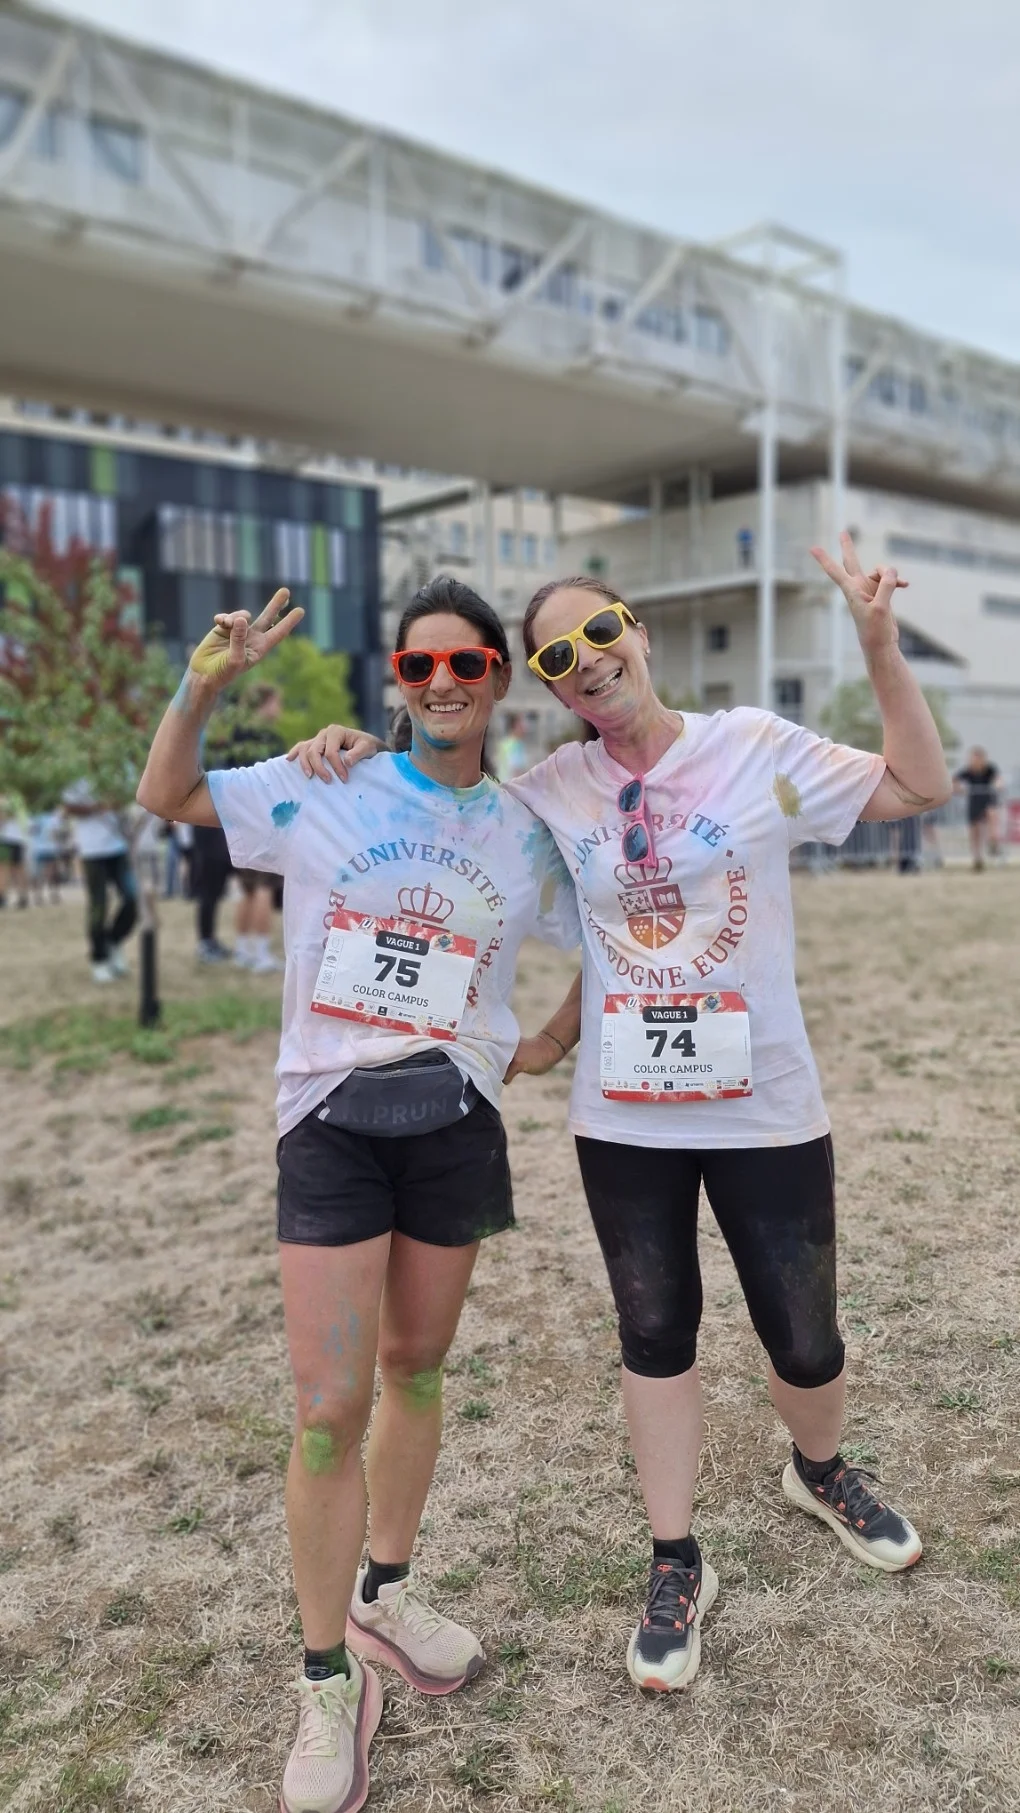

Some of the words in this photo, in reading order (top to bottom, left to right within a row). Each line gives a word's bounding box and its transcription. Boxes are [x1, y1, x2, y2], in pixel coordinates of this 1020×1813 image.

[574, 811, 730, 865] UNIVRSITÉ
[348, 838, 507, 912] UNIVERSITÉ
[690, 865, 748, 979] EUROPE
[386, 936, 414, 950] VAGUE
[415, 943, 420, 951] 1
[374, 953, 421, 988] 75
[466, 937, 504, 1007] ROPE
[352, 984, 386, 999] COLOR
[387, 992, 429, 1008] CAMPUS
[651, 1011, 682, 1019] VAGUE
[683, 1011, 688, 1019] 1
[645, 1029, 697, 1058] 74
[633, 1064, 667, 1074] COLOR
[669, 1064, 713, 1074] CAMPUS
